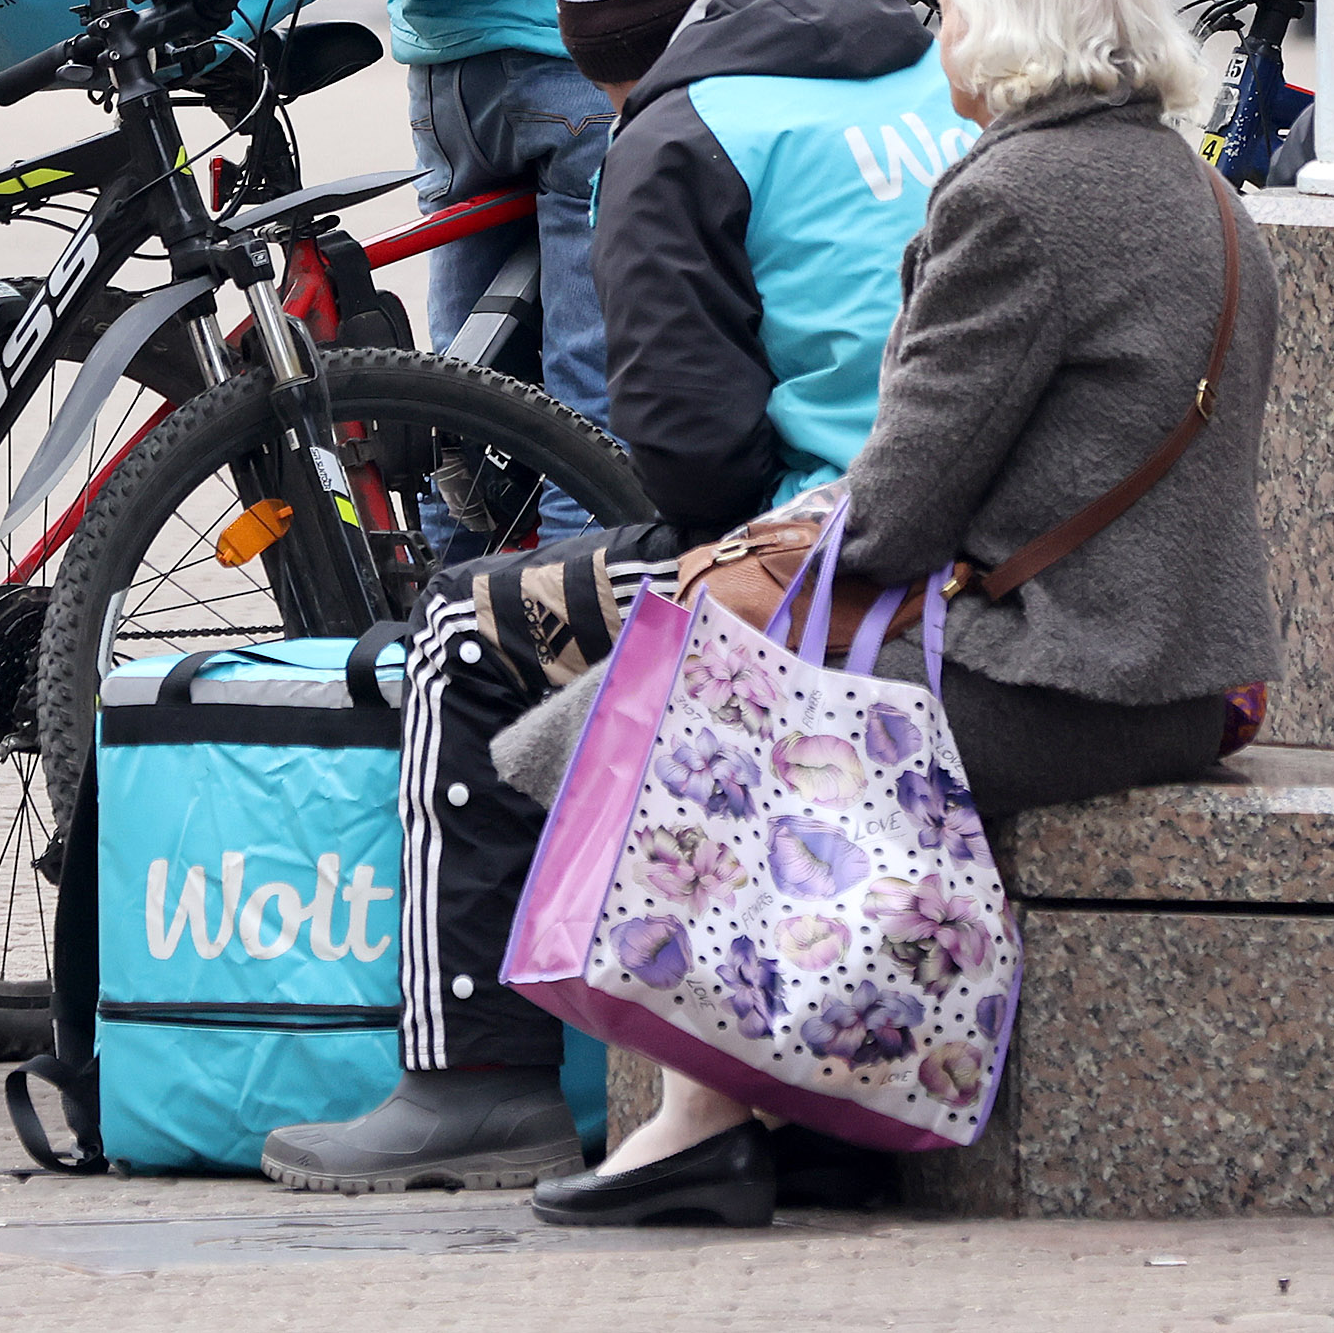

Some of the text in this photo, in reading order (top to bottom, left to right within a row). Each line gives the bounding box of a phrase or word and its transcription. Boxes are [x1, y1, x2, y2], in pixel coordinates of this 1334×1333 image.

[844, 113, 976, 201] Wo
[1202, 140, 1217, 161] 4
[673, 695, 703, 722] LOVE
[854, 811, 902, 841] LOVE
[146, 852, 393, 963] Wolt
[685, 978, 717, 1011] LOVE
[880, 1070, 913, 1085] LOVE
